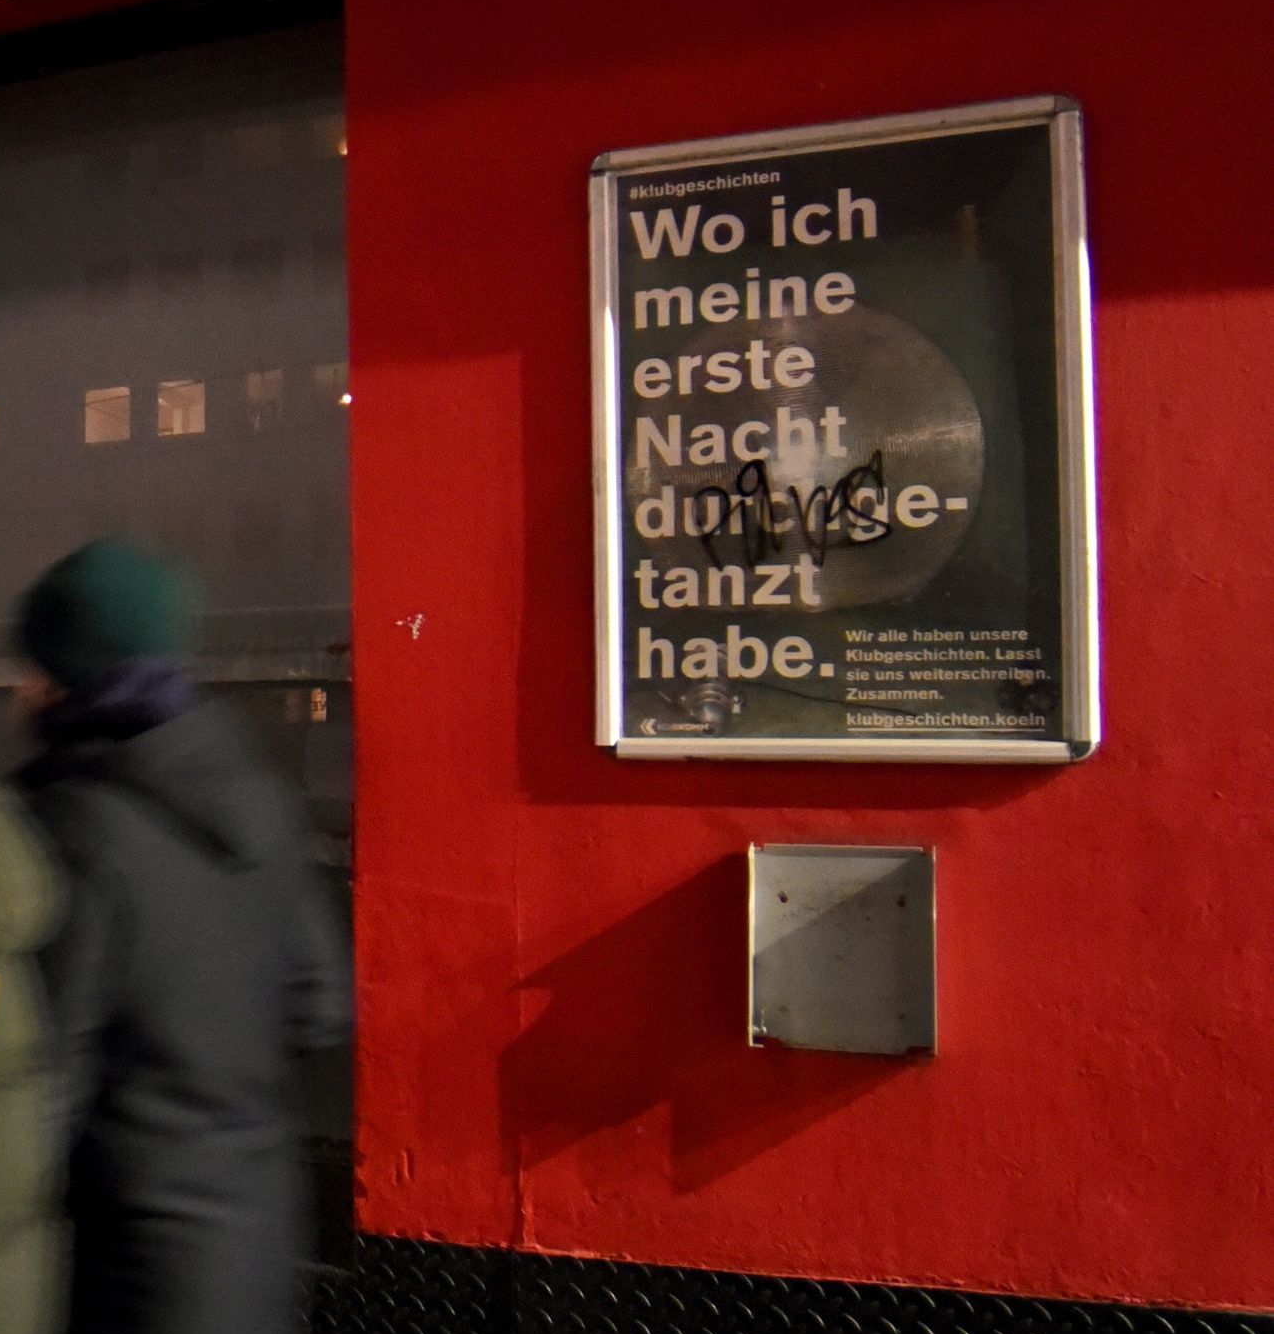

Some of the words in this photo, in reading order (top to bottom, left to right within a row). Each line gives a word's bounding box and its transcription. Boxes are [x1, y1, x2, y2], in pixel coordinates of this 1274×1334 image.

[629, 171, 781, 200] #klubgeschichten
[630, 204, 745, 260] Wo
[772, 187, 877, 247] ich
[634, 268, 856, 329] meine
[633, 340, 815, 398] erste
[636, 406, 847, 467] Nacht
[634, 483, 969, 542] durchge-
[634, 553, 821, 609] tanzt
[638, 625, 835, 679] habe.
[845, 630, 873, 643] Wir
[878, 630, 908, 642] alle
[913, 629, 964, 642] haben
[970, 630, 1028, 641] unsere
[845, 648, 990, 664] Klubgeschichten.
[995, 648, 1042, 660] Lasst
[845, 669, 870, 681] sie
[876, 670, 904, 681] uns
[910, 667, 1051, 681] weiterschreiben.
[845, 688, 944, 700] Zusammen.
[845, 713, 1046, 728] klubgeschichten.koeln
